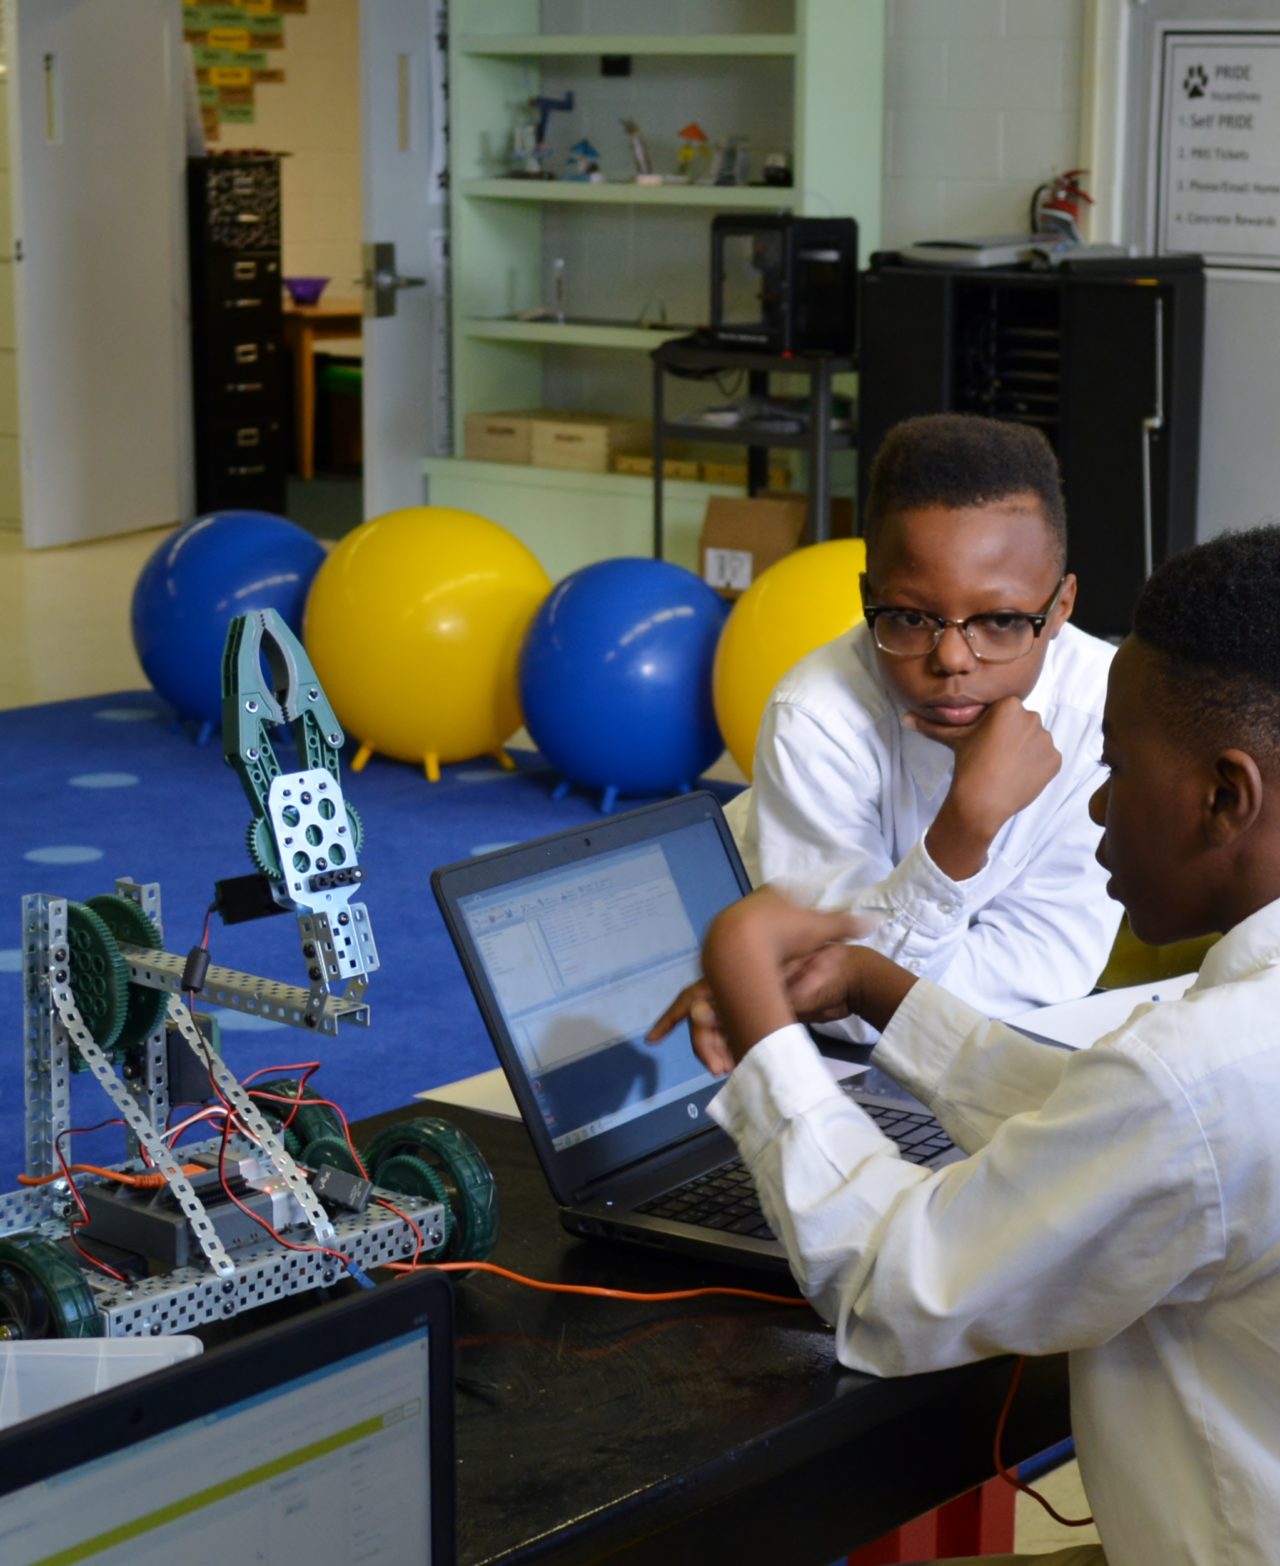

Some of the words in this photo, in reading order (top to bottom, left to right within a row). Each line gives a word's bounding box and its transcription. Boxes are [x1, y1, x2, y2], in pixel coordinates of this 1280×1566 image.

[1214, 64, 1253, 82] PRIDE
[1190, 112, 1215, 129] Self
[1218, 113, 1254, 131] PRIDE
